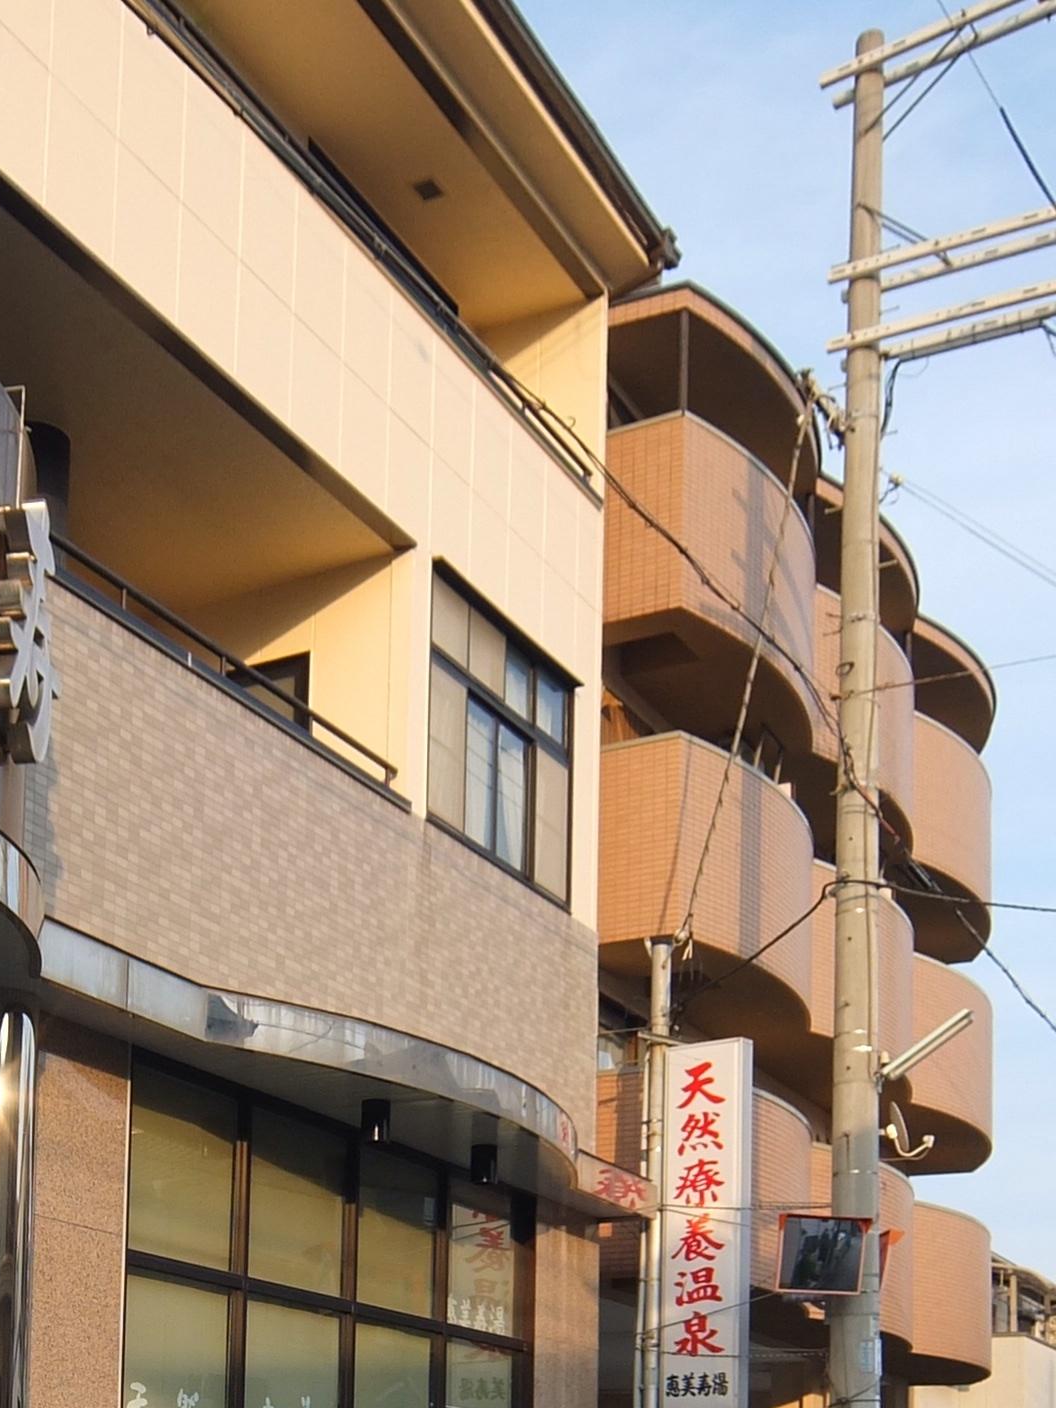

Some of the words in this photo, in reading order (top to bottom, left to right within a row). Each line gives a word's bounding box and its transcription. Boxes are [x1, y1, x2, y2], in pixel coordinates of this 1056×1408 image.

[671, 1061, 726, 1357] 天然療養温泉
